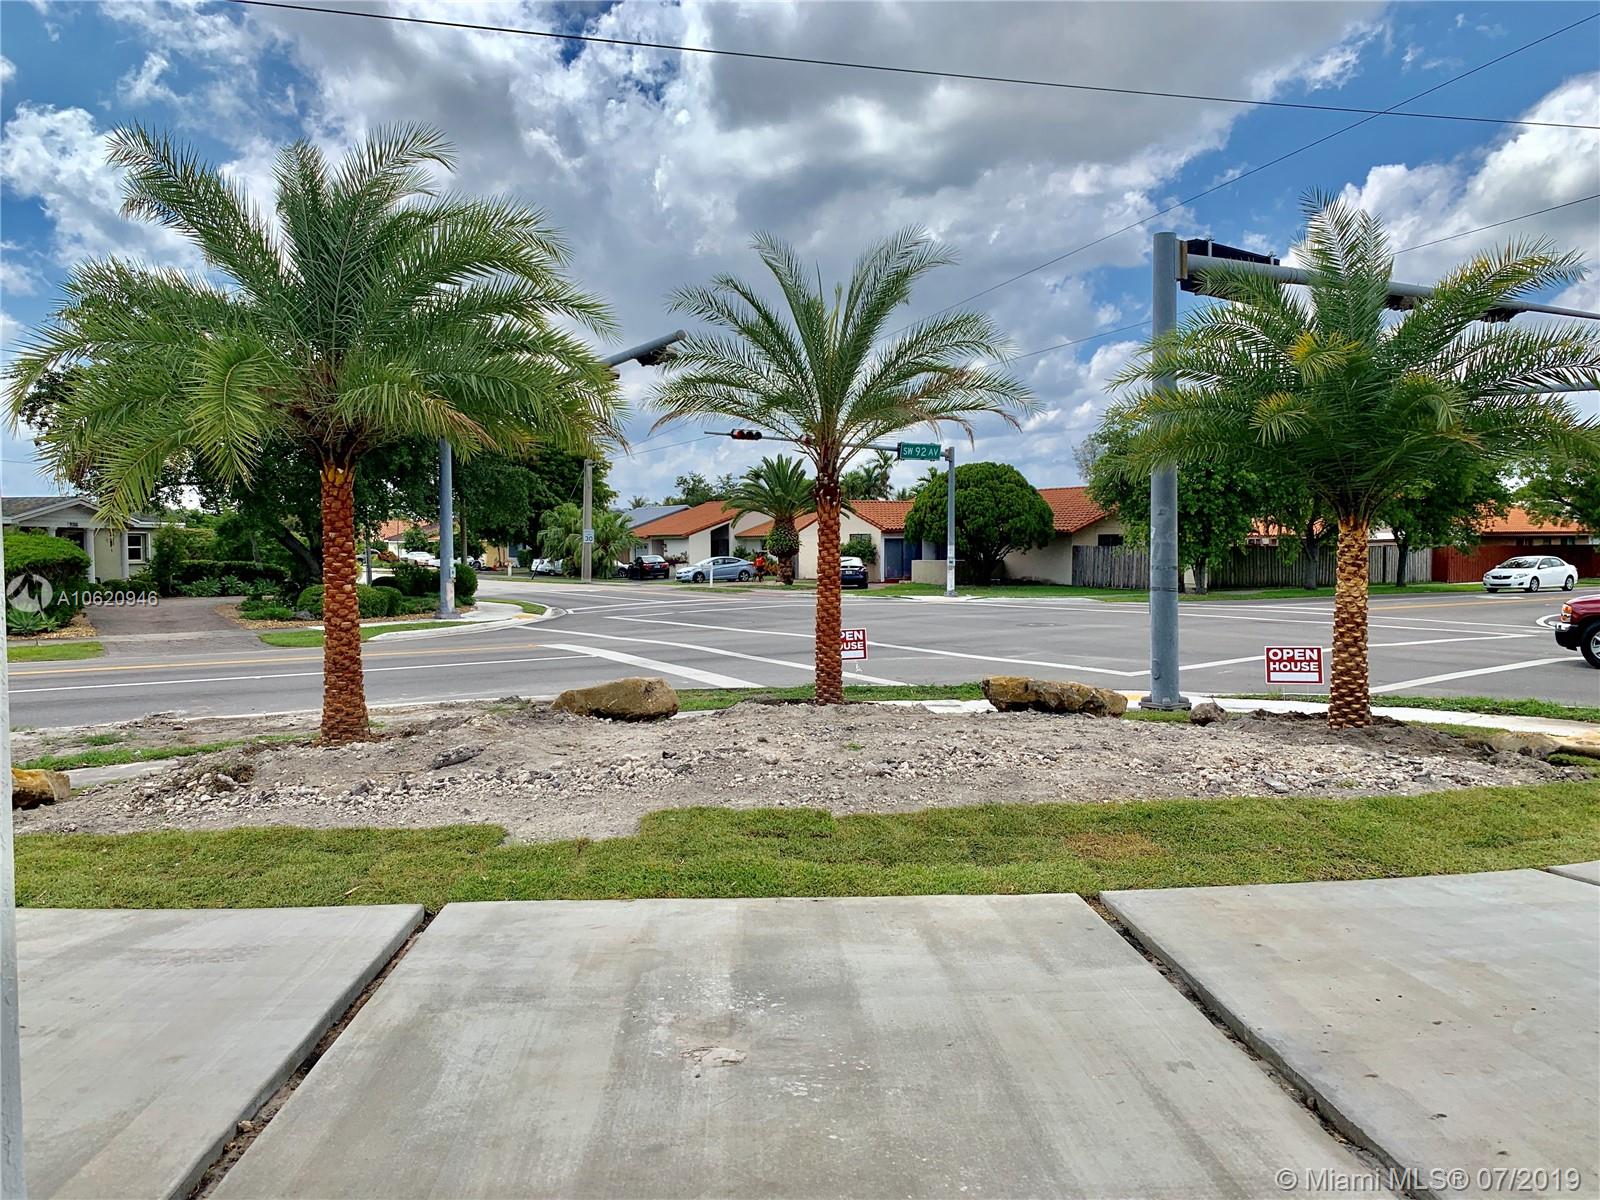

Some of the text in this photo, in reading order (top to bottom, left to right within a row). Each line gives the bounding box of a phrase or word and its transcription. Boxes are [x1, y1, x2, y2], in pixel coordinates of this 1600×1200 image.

[903, 446, 939, 457] SW 92 AV
[840, 630, 864, 641] PEN
[840, 641, 864, 650] USE
[1268, 648, 1318, 661] OPEN
[1269, 661, 1319, 671] HOUSE
